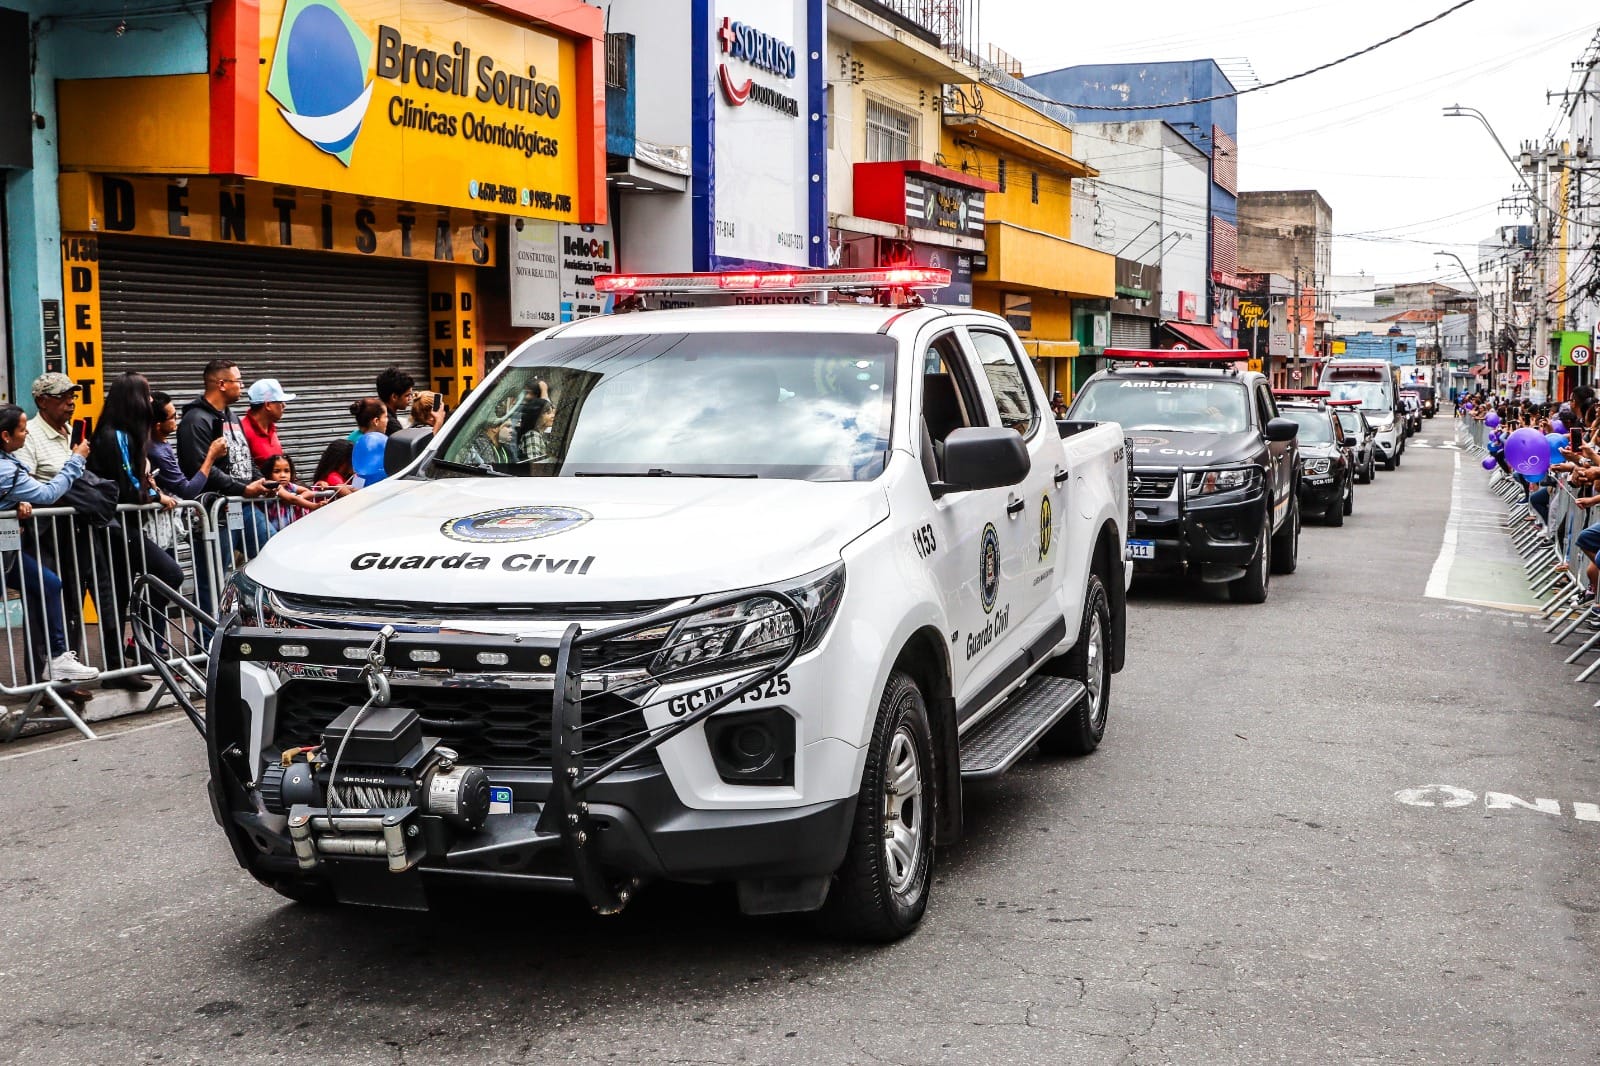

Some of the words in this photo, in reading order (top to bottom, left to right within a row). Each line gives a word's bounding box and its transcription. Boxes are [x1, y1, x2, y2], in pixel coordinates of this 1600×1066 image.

[730, 21, 796, 79] SORRISO
[377, 24, 470, 97] Brasil
[476, 55, 560, 119] Sorriso
[462, 111, 558, 158] Odontológicas
[103, 177, 489, 264] DENTISTAS
[518, 250, 556, 264] CONSTRUTORA
[1539, 358, 1545, 366] E
[1574, 350, 1588, 359] 30
[1120, 380, 1214, 390] Ambiental
[1159, 448, 1213, 457] Civil
[350, 552, 491, 571] Guarda
[501, 553, 596, 575] Civil
[966, 619, 993, 661] Guarda
[993, 603, 1010, 636] Civil
[667, 686, 724, 717] GCM
